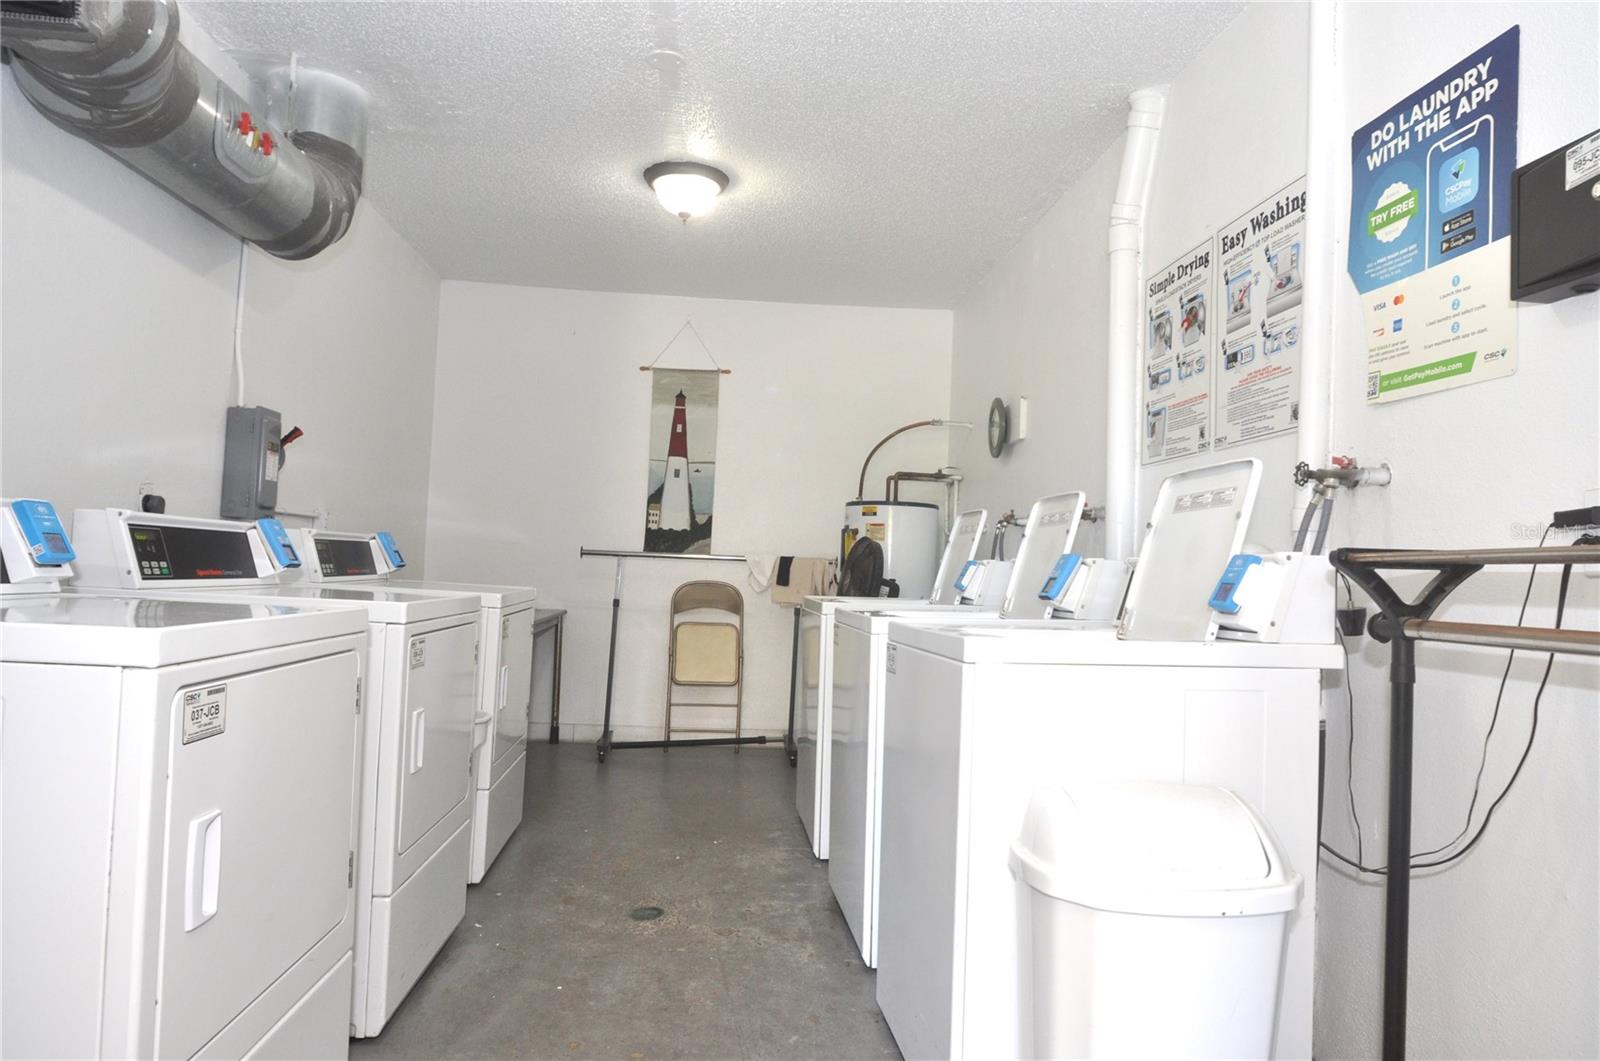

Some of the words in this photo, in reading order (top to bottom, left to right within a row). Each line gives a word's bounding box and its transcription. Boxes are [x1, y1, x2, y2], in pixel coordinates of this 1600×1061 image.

[1371, 121, 1395, 150] DO
[1399, 56, 1493, 130] LAUNDRY
[1366, 130, 1410, 172] WITH
[1414, 105, 1451, 143] THE
[1455, 78, 1499, 120] APP
[1221, 227, 1248, 255] Easy
[1250, 191, 1306, 235] Washing
[1370, 210, 1389, 227] TRY
[1389, 197, 1415, 218] FREE
[1149, 271, 1176, 298] Simple
[1177, 251, 1210, 281] Drying
[1373, 302, 1387, 311] VISA
[1483, 350, 1500, 360] CSC
[1403, 361, 1463, 382] GetPayMobile.com
[191, 704, 219, 721] 037-JCB
